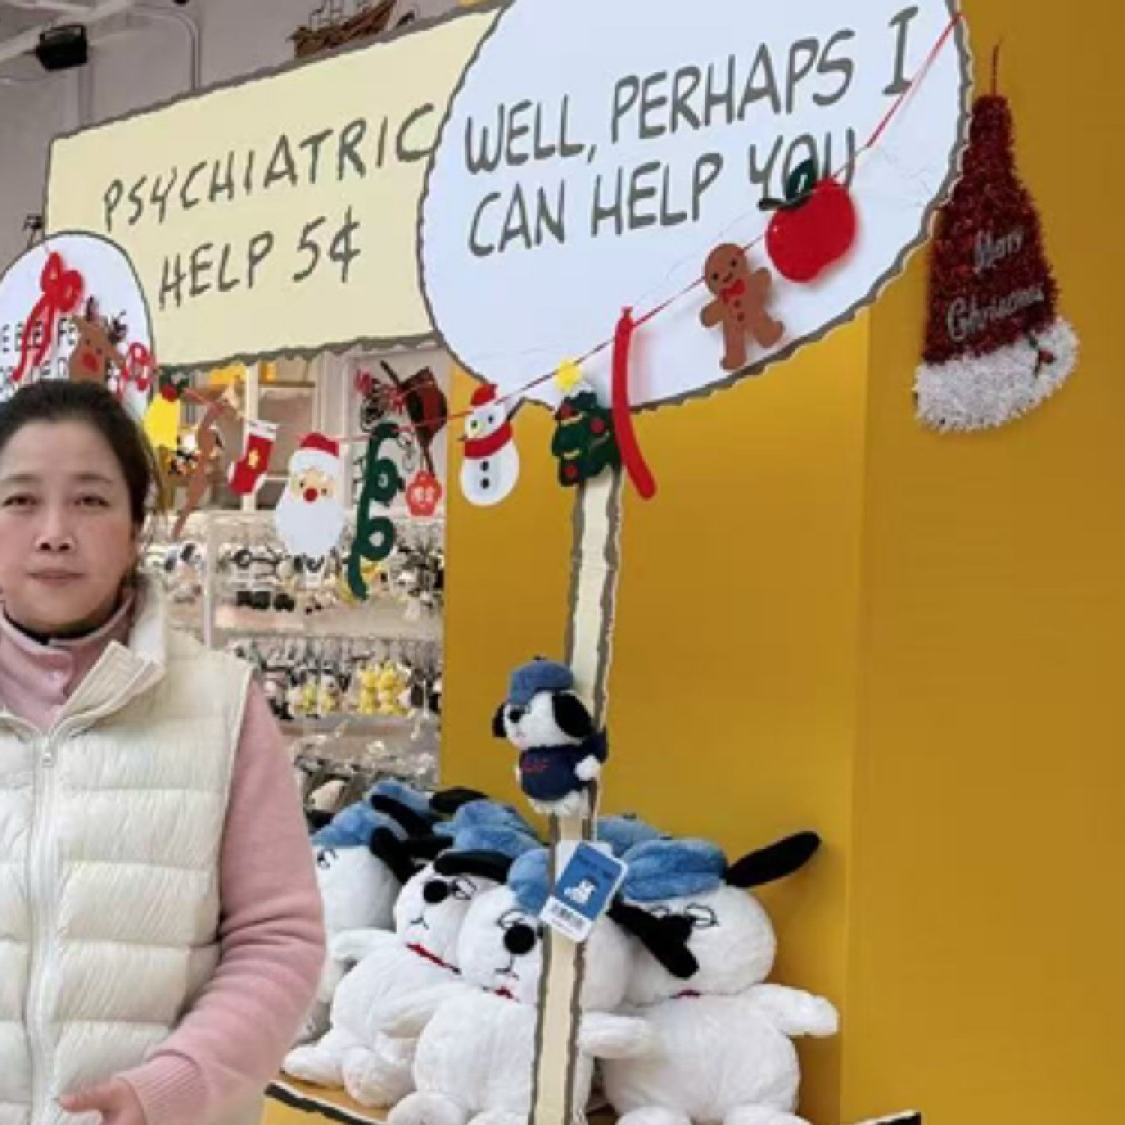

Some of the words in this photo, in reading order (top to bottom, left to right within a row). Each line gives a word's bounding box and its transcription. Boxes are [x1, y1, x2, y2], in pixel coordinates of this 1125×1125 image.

[464, 94, 597, 175] WELL,
[611, 28, 856, 144] PERHAPS
[882, 6, 918, 95] I
[103, 102, 435, 233] PSYCHIATRIC
[468, 180, 565, 257] CAN
[590, 151, 723, 238] HELP
[159, 230, 274, 311] HELP
[293, 204, 361, 284] 5¢
